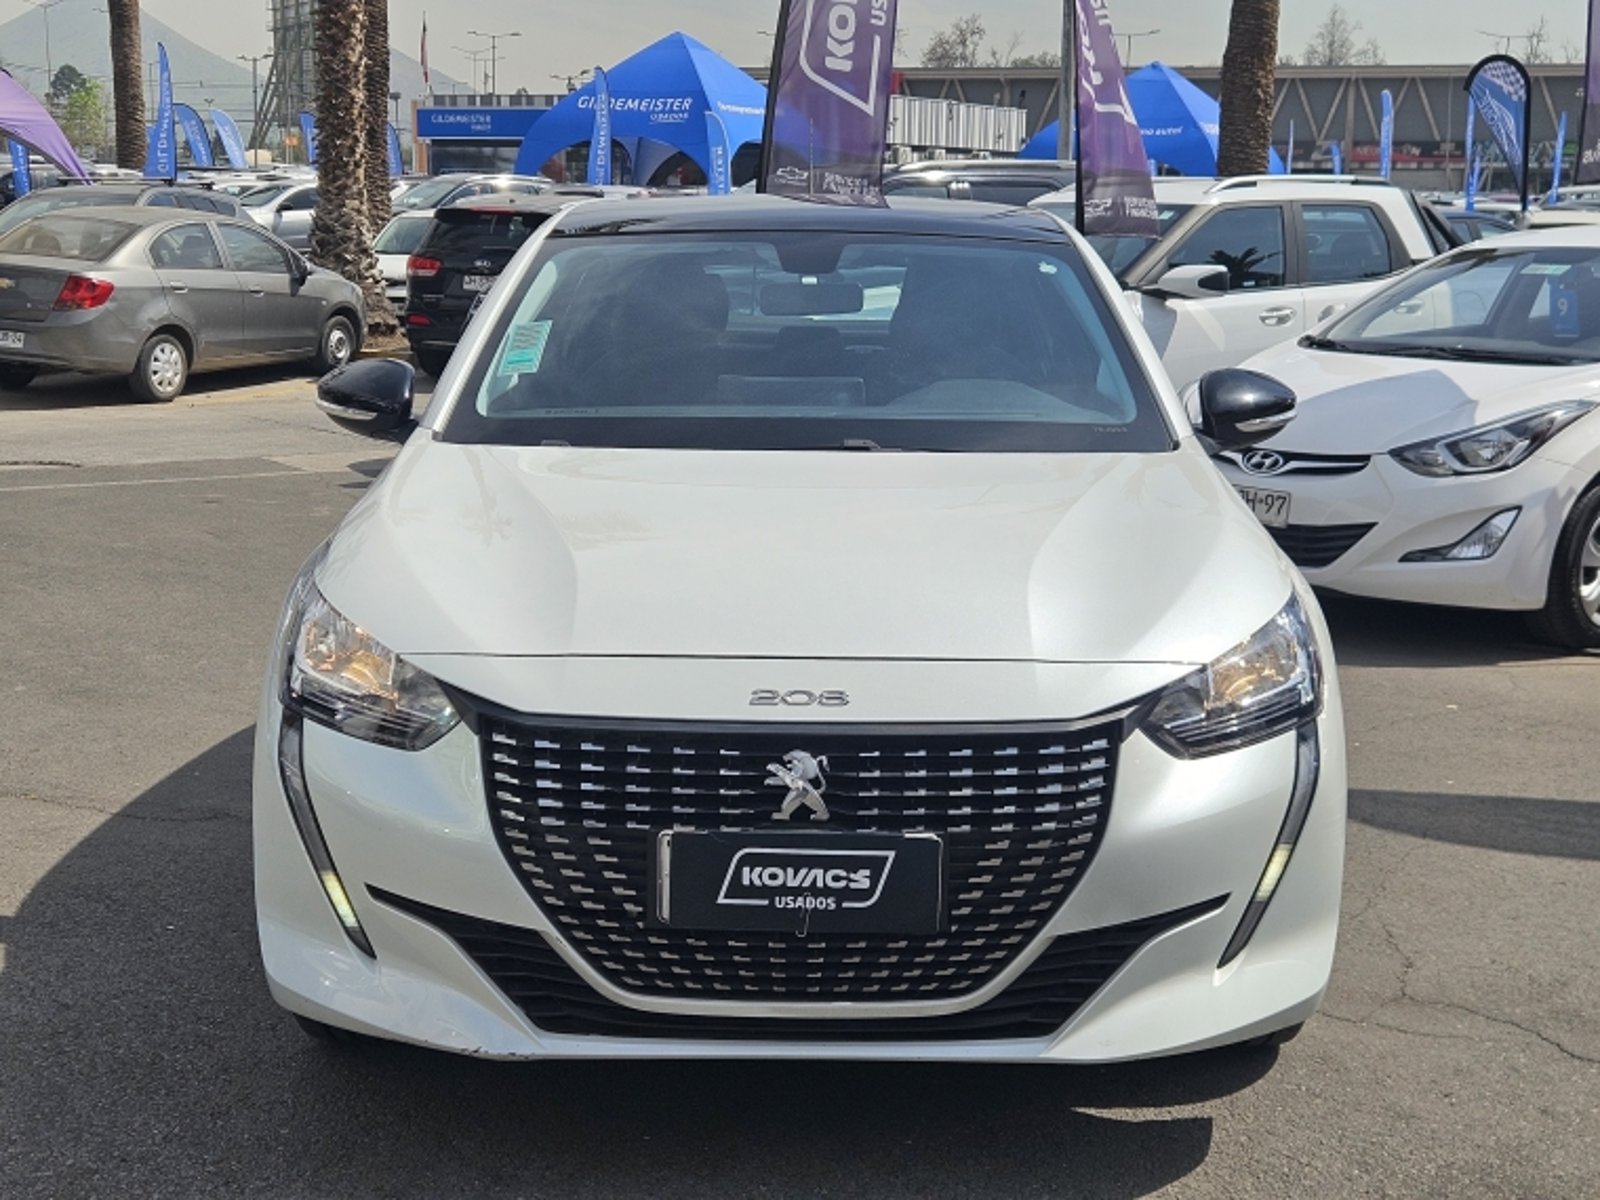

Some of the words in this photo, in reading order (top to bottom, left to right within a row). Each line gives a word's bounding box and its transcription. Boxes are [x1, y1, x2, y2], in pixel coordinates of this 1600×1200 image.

[577, 96, 693, 112] GIEMEISTER
[1557, 298, 1568, 316] 9
[749, 689, 851, 706] 208
[742, 867, 871, 889] KOVACS
[774, 896, 837, 910] USADOS
